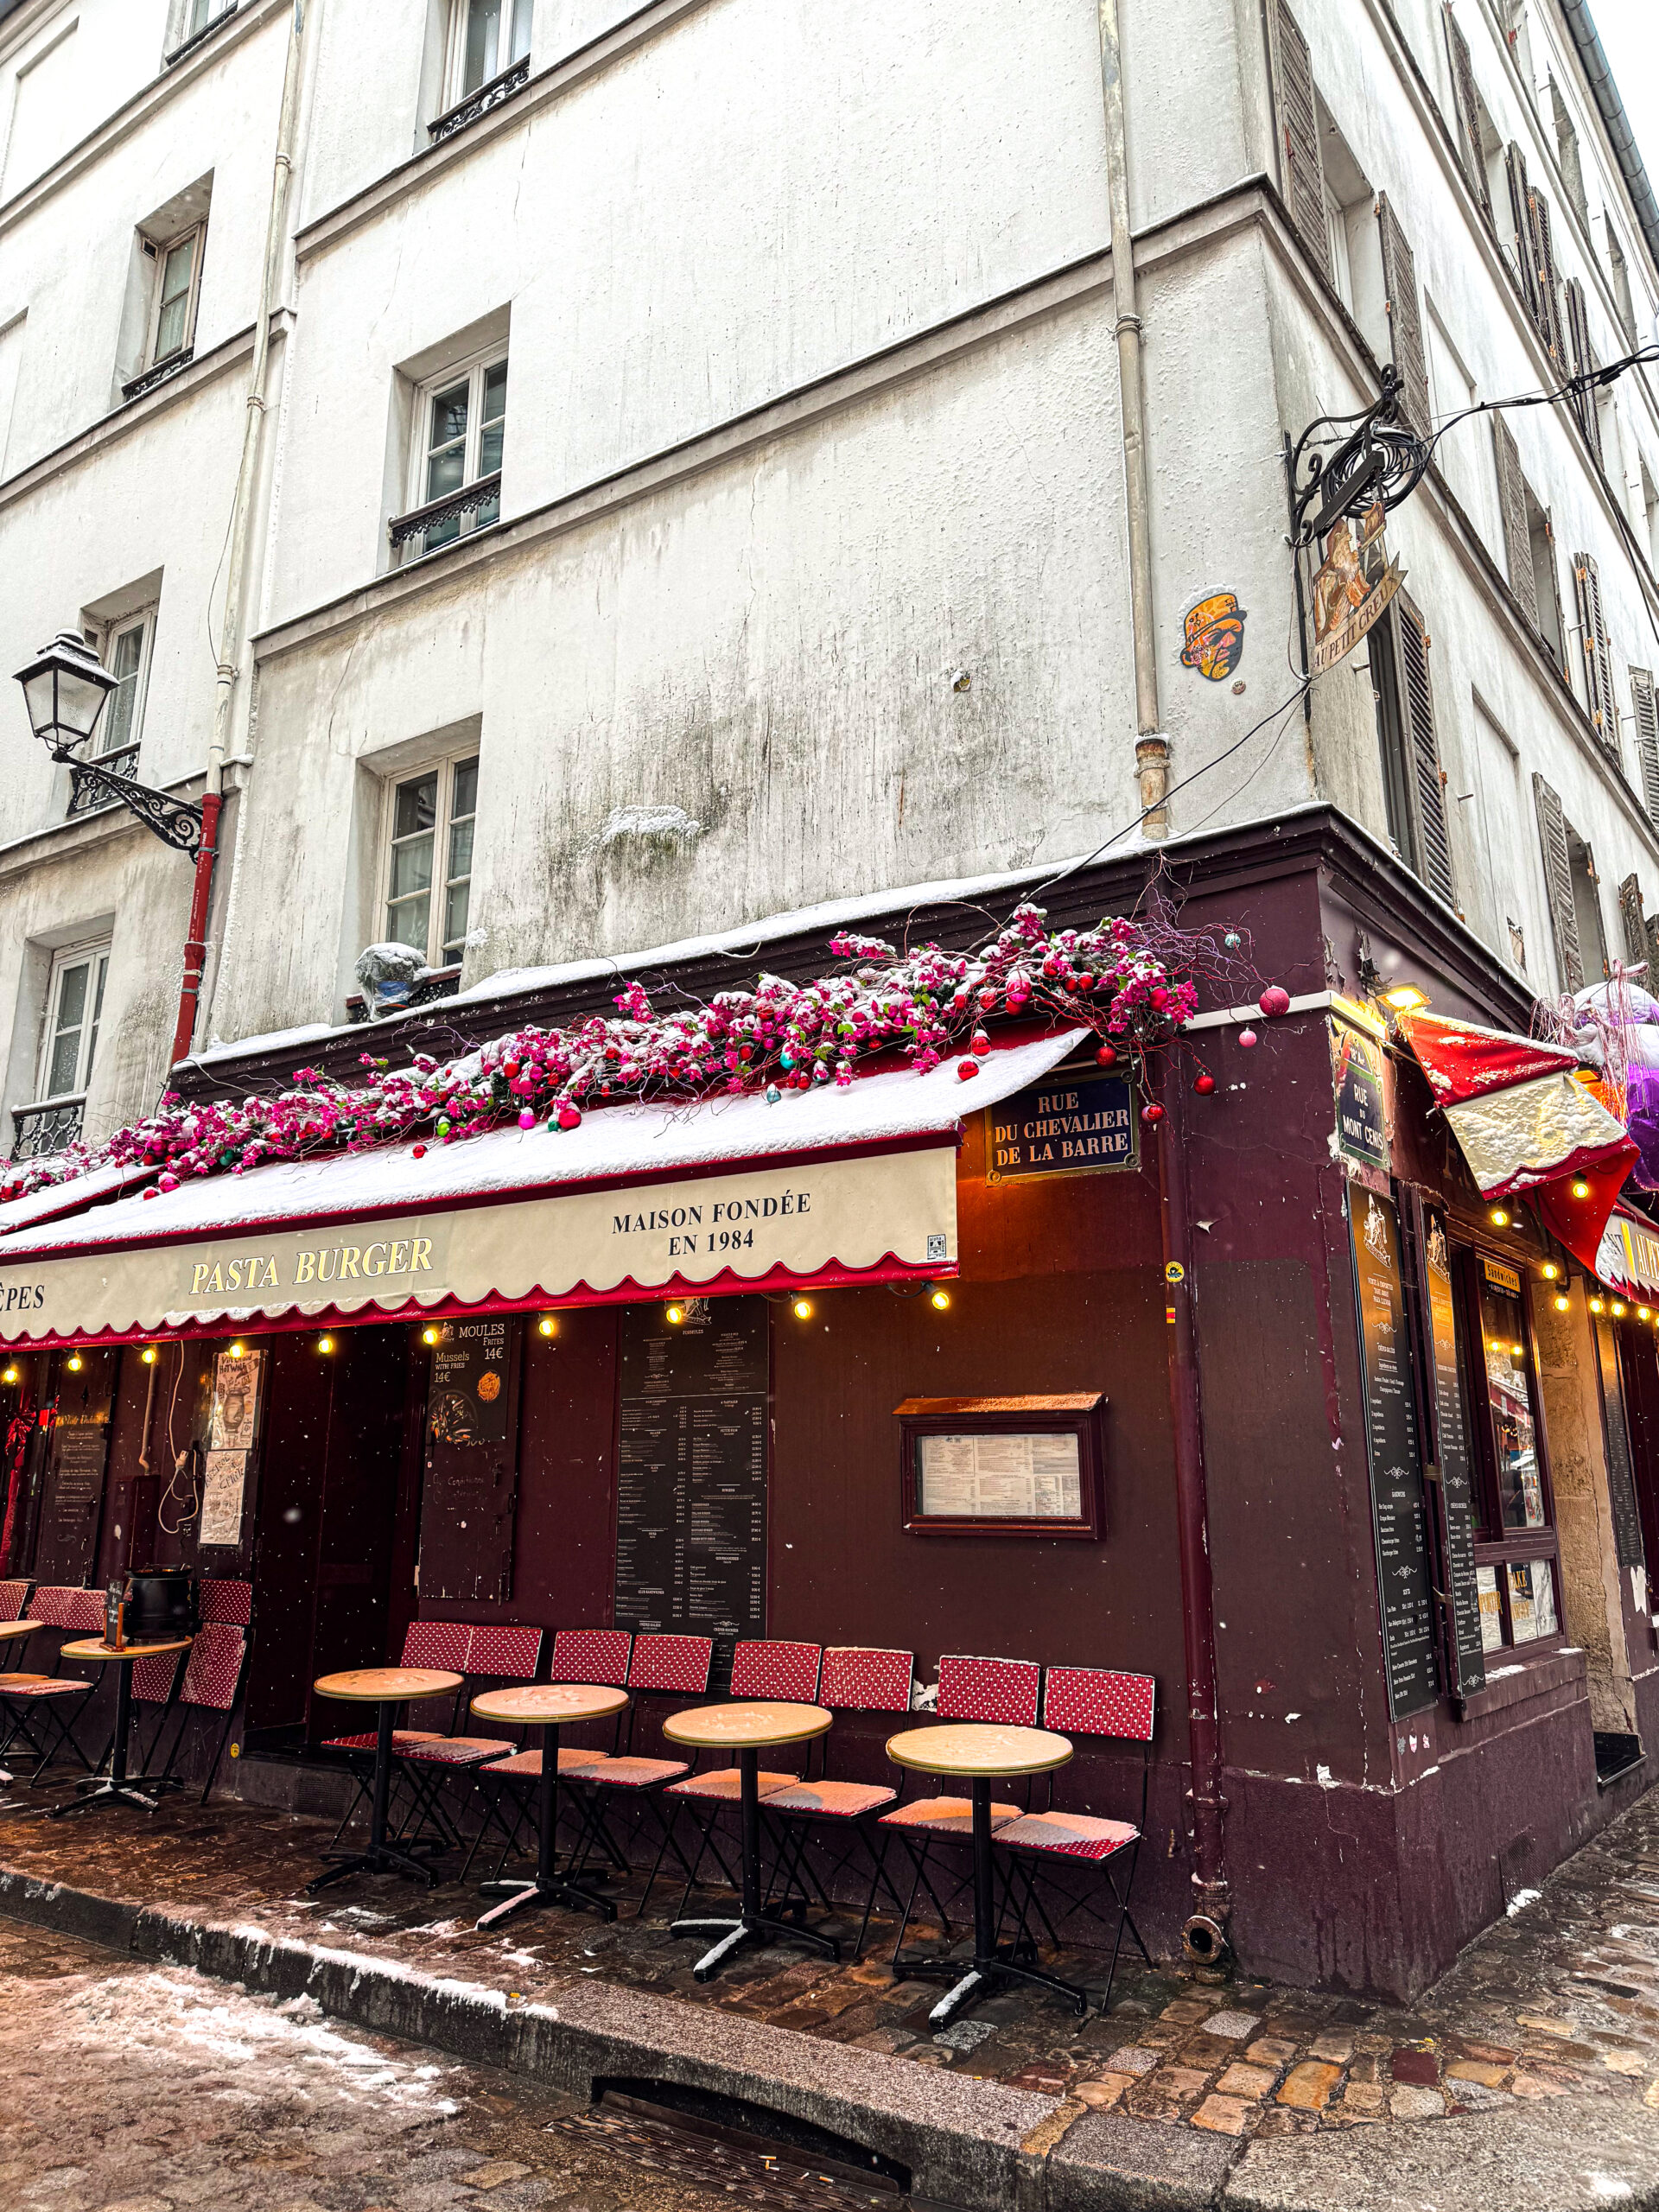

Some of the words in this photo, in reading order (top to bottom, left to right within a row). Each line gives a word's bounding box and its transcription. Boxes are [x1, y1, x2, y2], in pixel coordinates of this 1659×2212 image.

[1313, 648, 1328, 668] AU
[1329, 625, 1356, 659] PETIT
[1358, 576, 1398, 630] CREUX
[1038, 1092, 1078, 1114] RUE
[1353, 1083, 1369, 1108] RUE
[995, 1124, 1018, 1142] DU
[1024, 1109, 1129, 1139] CHEVALIER
[1359, 1109, 1366, 1120] DU
[1343, 1115, 1363, 1141] MONT
[1364, 1125, 1383, 1150] CENIS
[996, 1147, 1020, 1166] DE
[1029, 1143, 1054, 1162] LA
[1062, 1133, 1128, 1158] BARRE
[612, 1205, 703, 1235] MAISON
[712, 1189, 811, 1223] FONDÉE
[667, 1234, 698, 1256] EN
[707, 1228, 754, 1253] 1984
[188, 1255, 280, 1295] PASTA
[293, 1236, 434, 1286] BURGER
[459, 1324, 505, 1338] MOULES
[435, 1351, 469, 1363] Mussels
[485, 1347, 503, 1360] 14€
[435, 1371, 450, 1382] 14€
